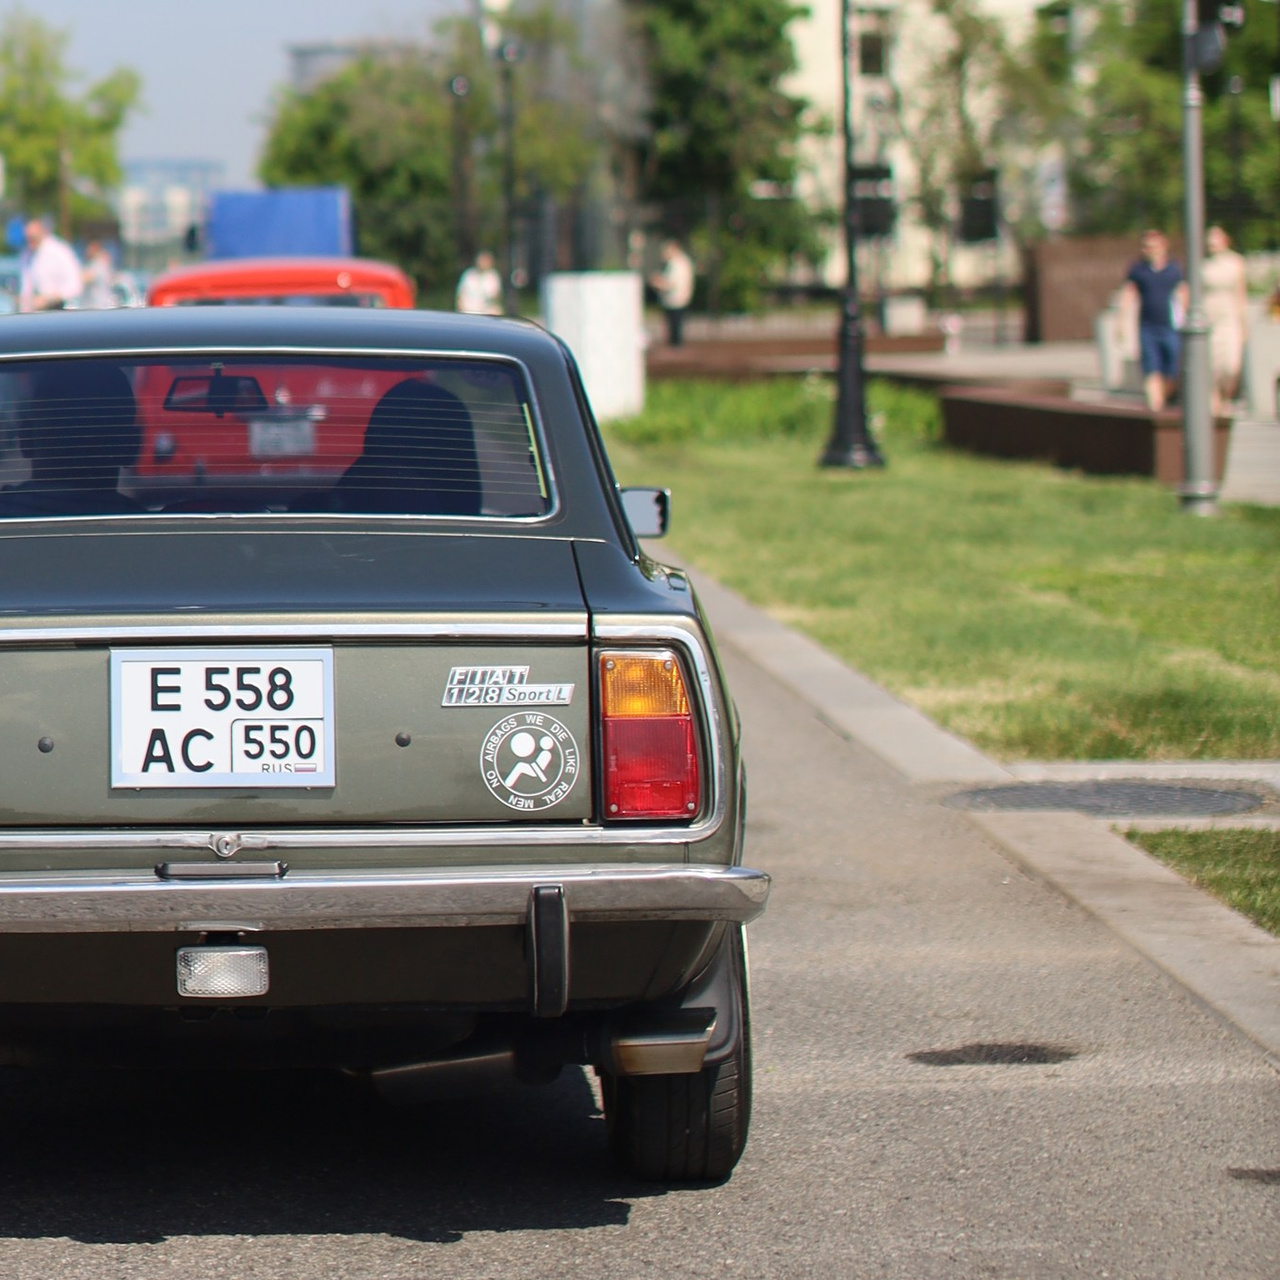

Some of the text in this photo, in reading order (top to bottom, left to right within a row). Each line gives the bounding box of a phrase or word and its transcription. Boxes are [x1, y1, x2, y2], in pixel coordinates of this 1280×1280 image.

[150, 666, 294, 711] E 558
[451, 669, 528, 685] FIAT
[449, 686, 567, 703] 128 Sport L
[141, 728, 214, 772] AC
[243, 725, 316, 759] 550
[262, 763, 293, 772] RUS
[484, 714, 576, 808] NO AIRBAGS WE DIE LIKE REAL MEN
